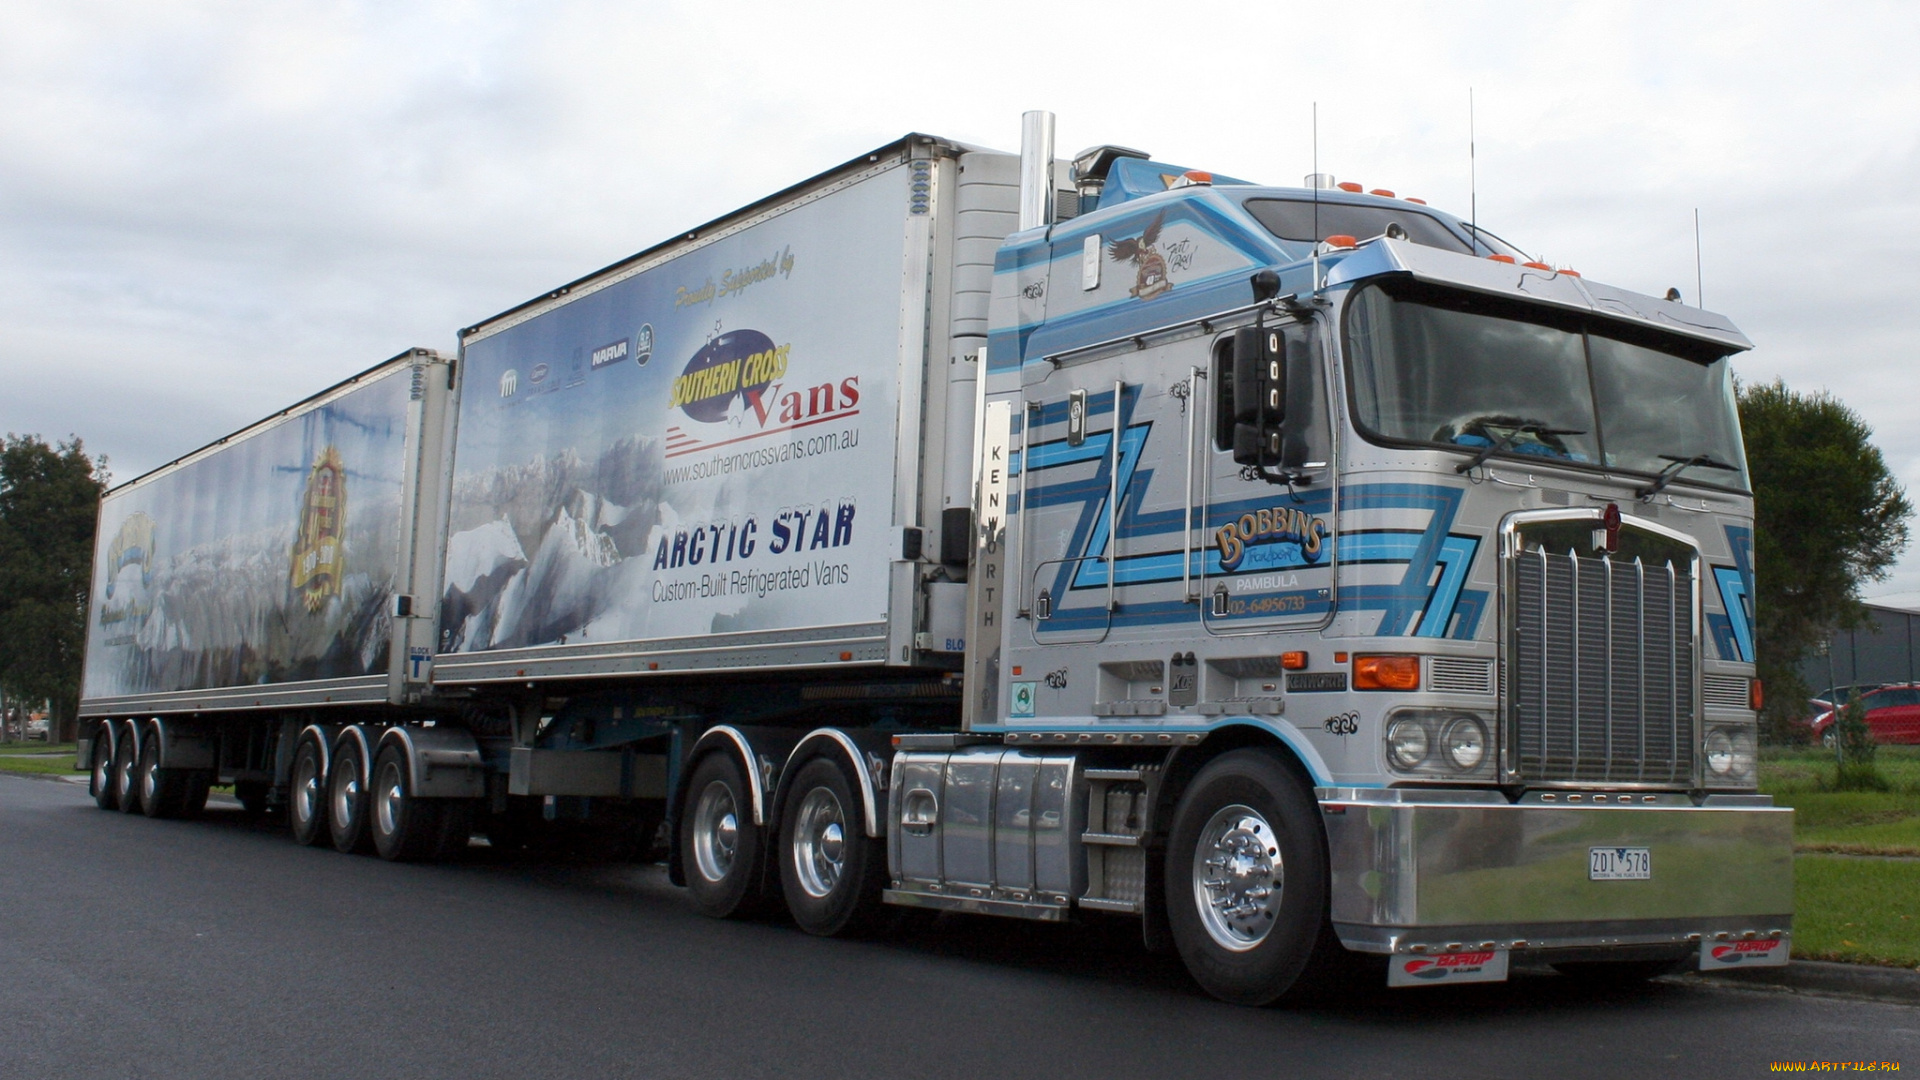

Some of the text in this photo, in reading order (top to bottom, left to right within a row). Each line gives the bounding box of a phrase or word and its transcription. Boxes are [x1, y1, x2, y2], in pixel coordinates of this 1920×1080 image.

[718, 250, 777, 297] Supported
[780, 244, 794, 280] by
[668, 343, 791, 410] SOUTHERN CROSS
[746, 375, 860, 429] Vans
[663, 428, 860, 486] www.southerncrossvans.com.au
[653, 496, 856, 571] ARCTIC STAR
[984, 446, 1001, 627] KENWORTH
[1216, 506, 1326, 572] BOBBINS
[652, 560, 849, 603] Custom-Built Refrigerated Vans
[1230, 596, 1305, 615] 02-64956733
[1236, 575, 1299, 592] PAMBULA
[945, 639, 966, 651] BLO
[1285, 673, 1346, 690] KENWORTH
[1593, 853, 1648, 872] ZDI 578
